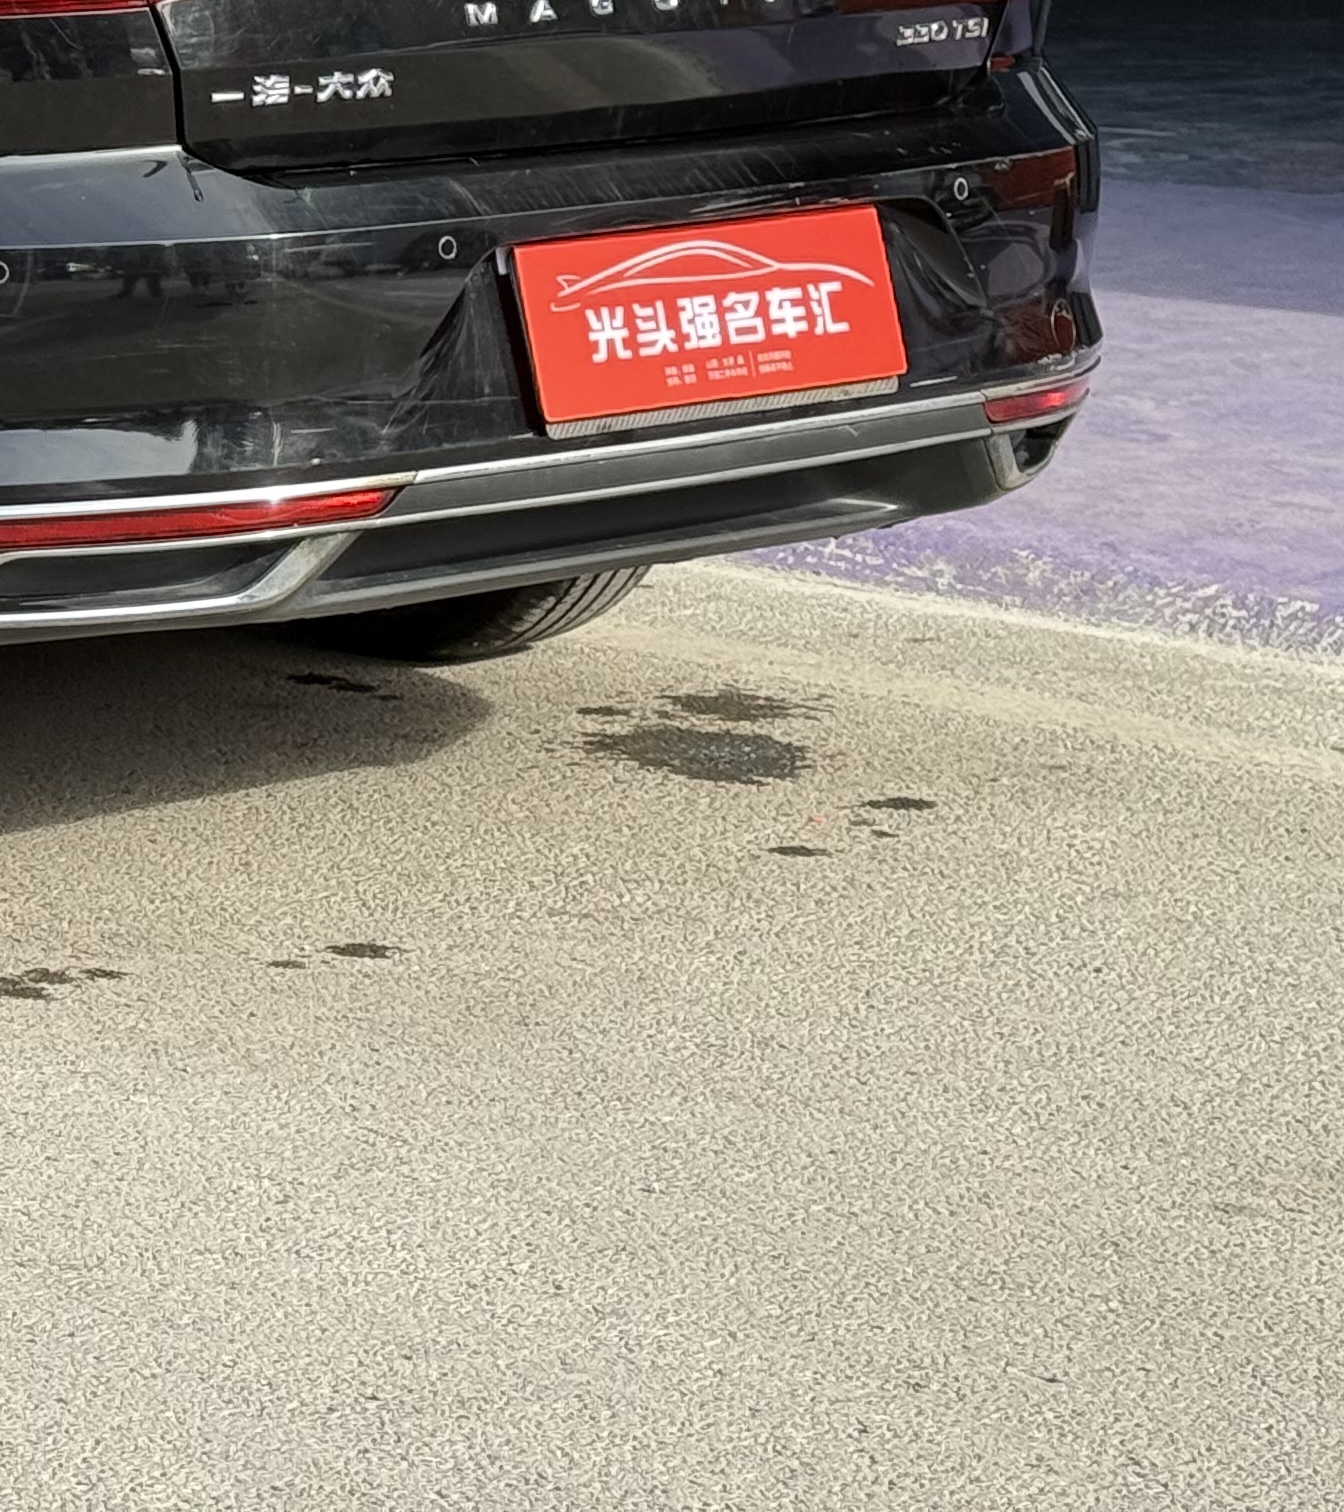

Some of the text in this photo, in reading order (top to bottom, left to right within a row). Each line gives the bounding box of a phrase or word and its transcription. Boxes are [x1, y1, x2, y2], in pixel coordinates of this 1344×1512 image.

[896, 16, 990, 47] 330 TSI
[211, 67, 395, 108] 一汽-大众
[584, 280, 851, 364] 光头强名车汇
